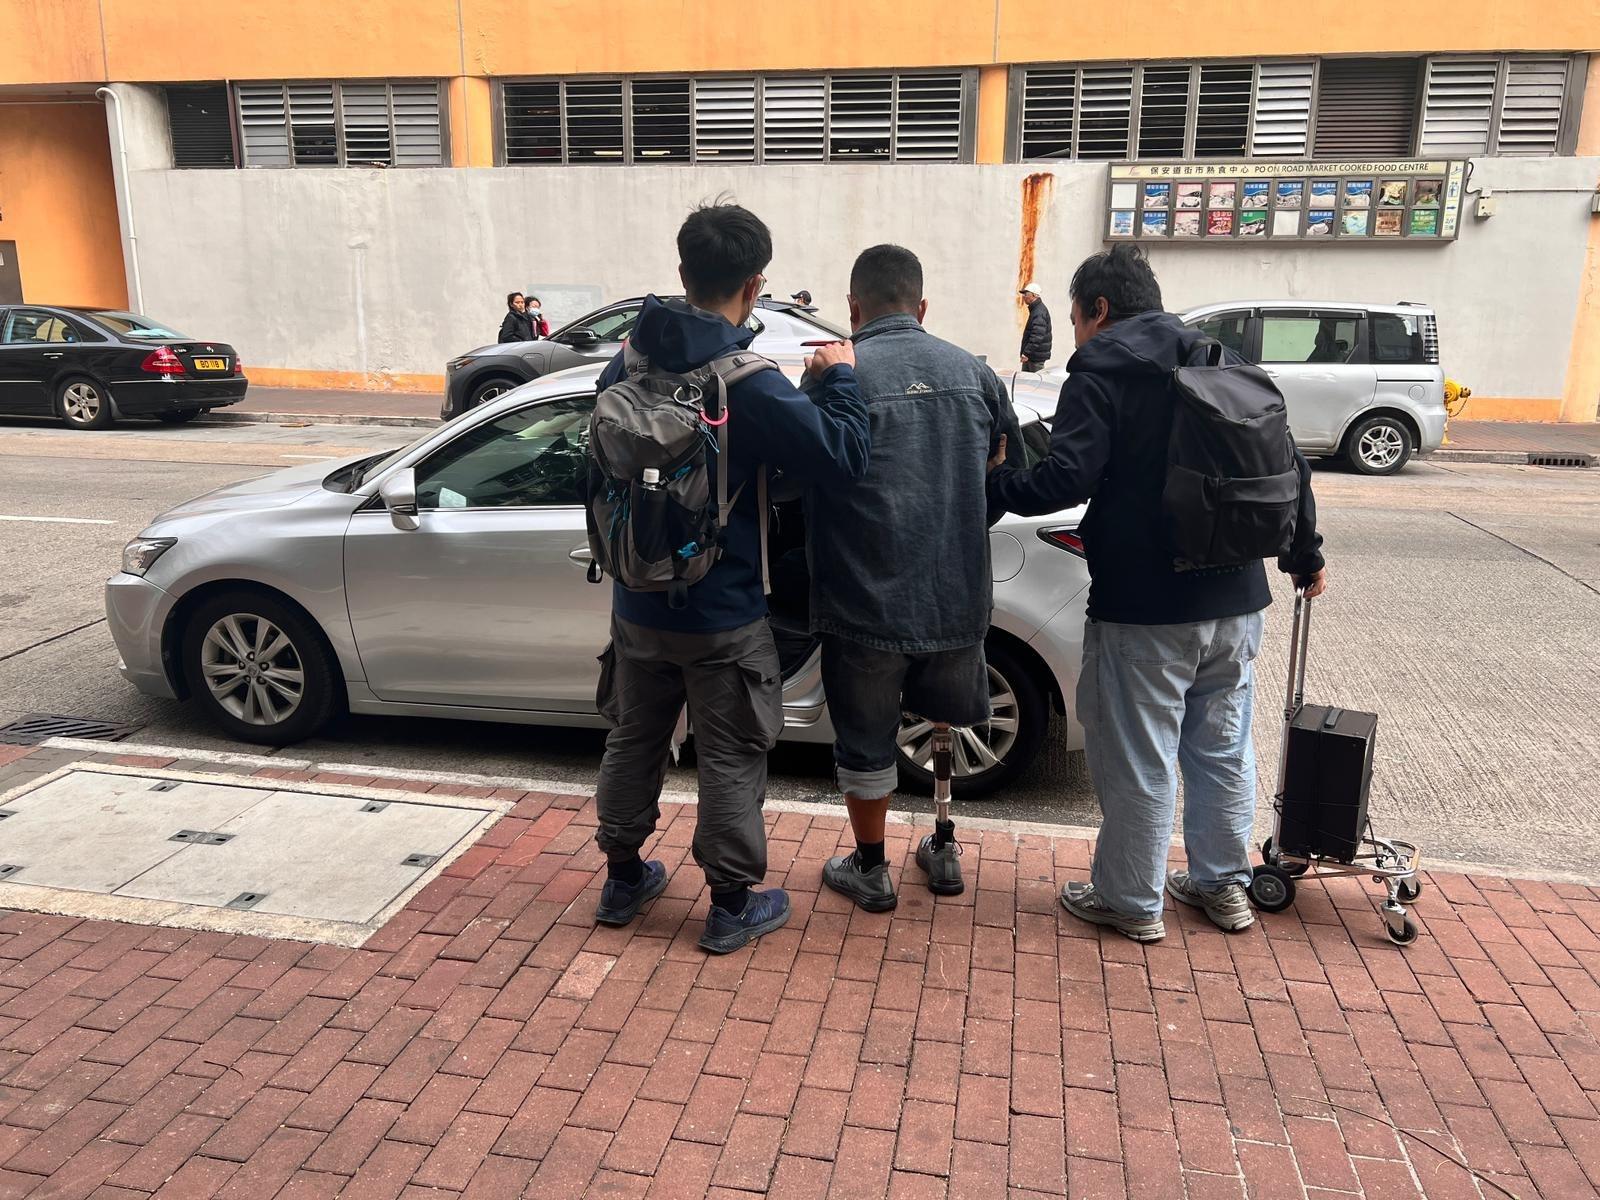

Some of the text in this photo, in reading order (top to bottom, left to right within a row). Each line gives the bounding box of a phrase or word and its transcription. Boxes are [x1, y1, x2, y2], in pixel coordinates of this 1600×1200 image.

[1150, 166, 1250, 175] 保安道街市熱食中心
[1281, 164, 1304, 173] ROAD
[1305, 164, 1338, 172] MARKET
[1339, 163, 1373, 172] COOKED
[1374, 163, 1397, 172] FOOD
[1398, 163, 1429, 171] CENTRE
